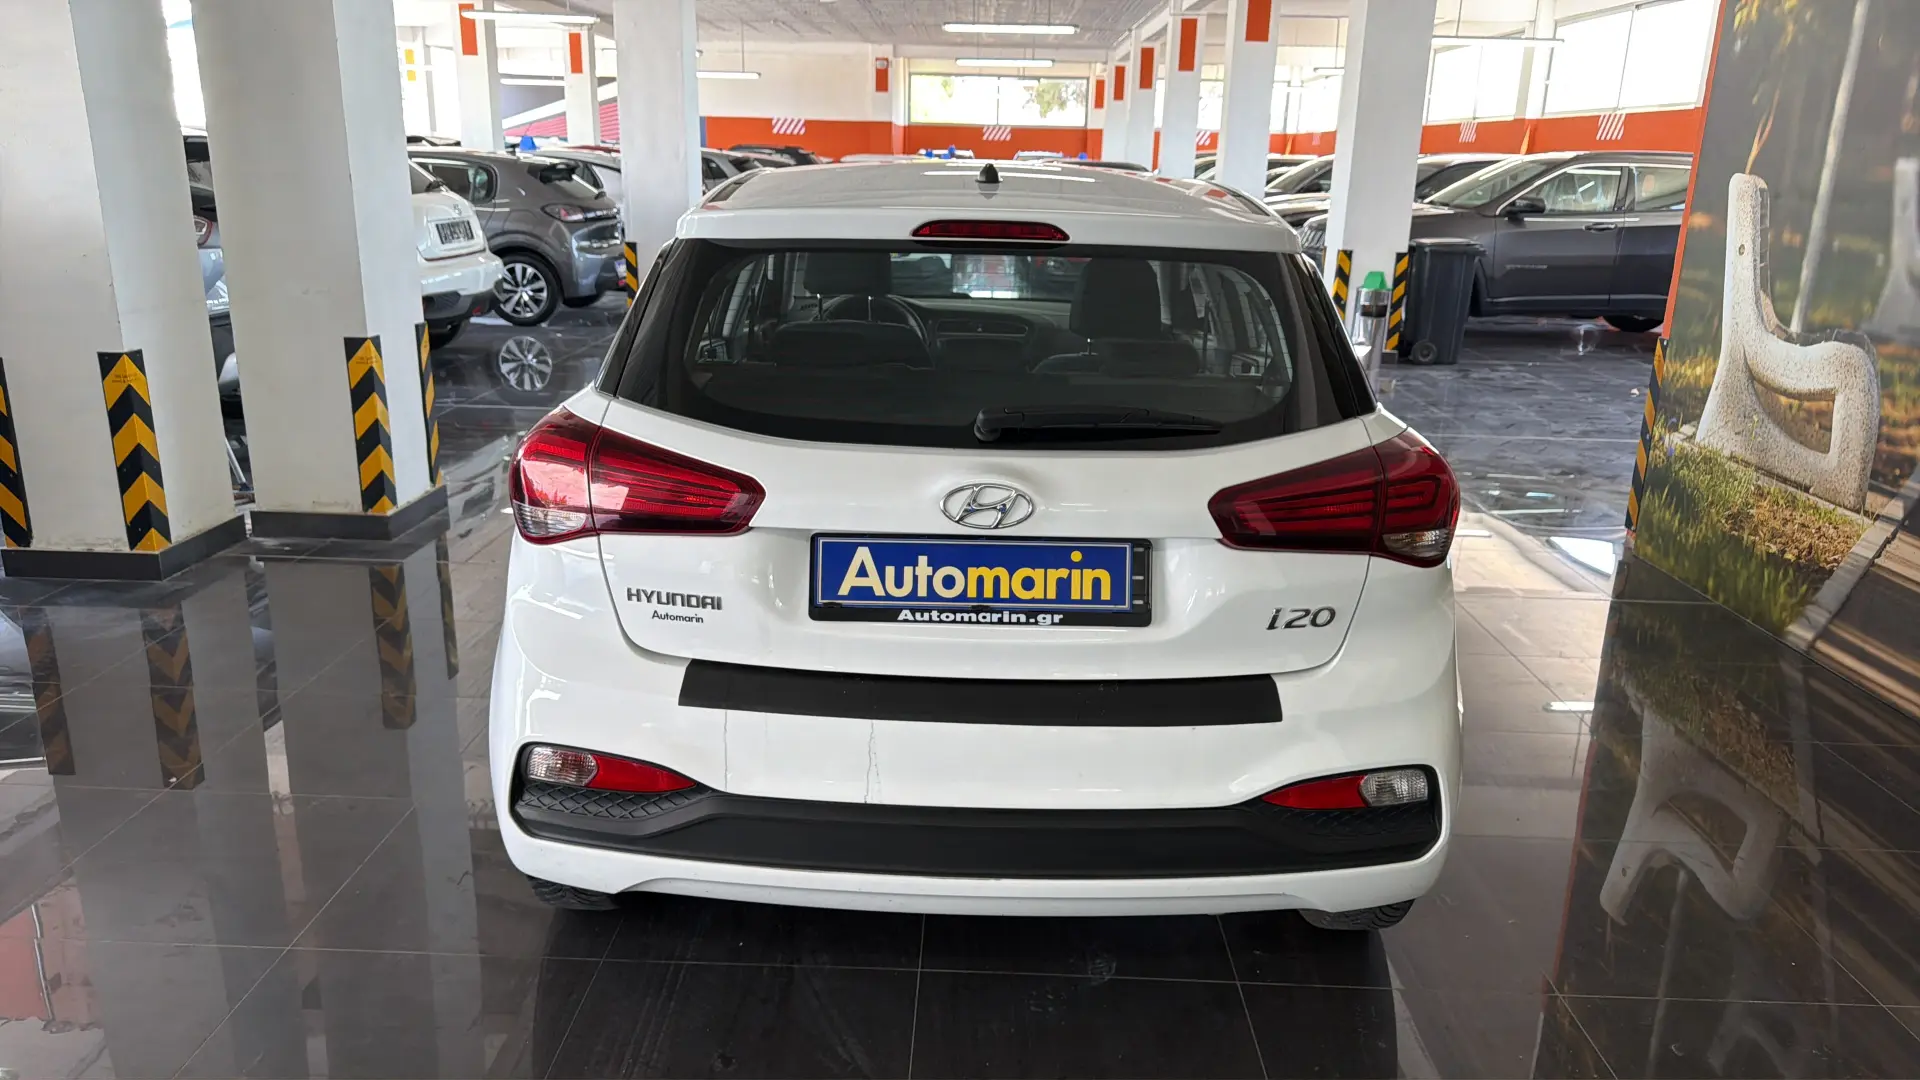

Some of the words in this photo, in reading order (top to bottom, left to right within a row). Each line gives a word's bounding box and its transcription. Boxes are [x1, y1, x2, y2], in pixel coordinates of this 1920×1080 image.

[837, 546, 1111, 600] Automarin
[626, 587, 722, 611] HYUNDAI
[652, 609, 704, 623] Automarin
[897, 609, 1063, 625] Automarin.gr
[1266, 606, 1336, 630] i20
